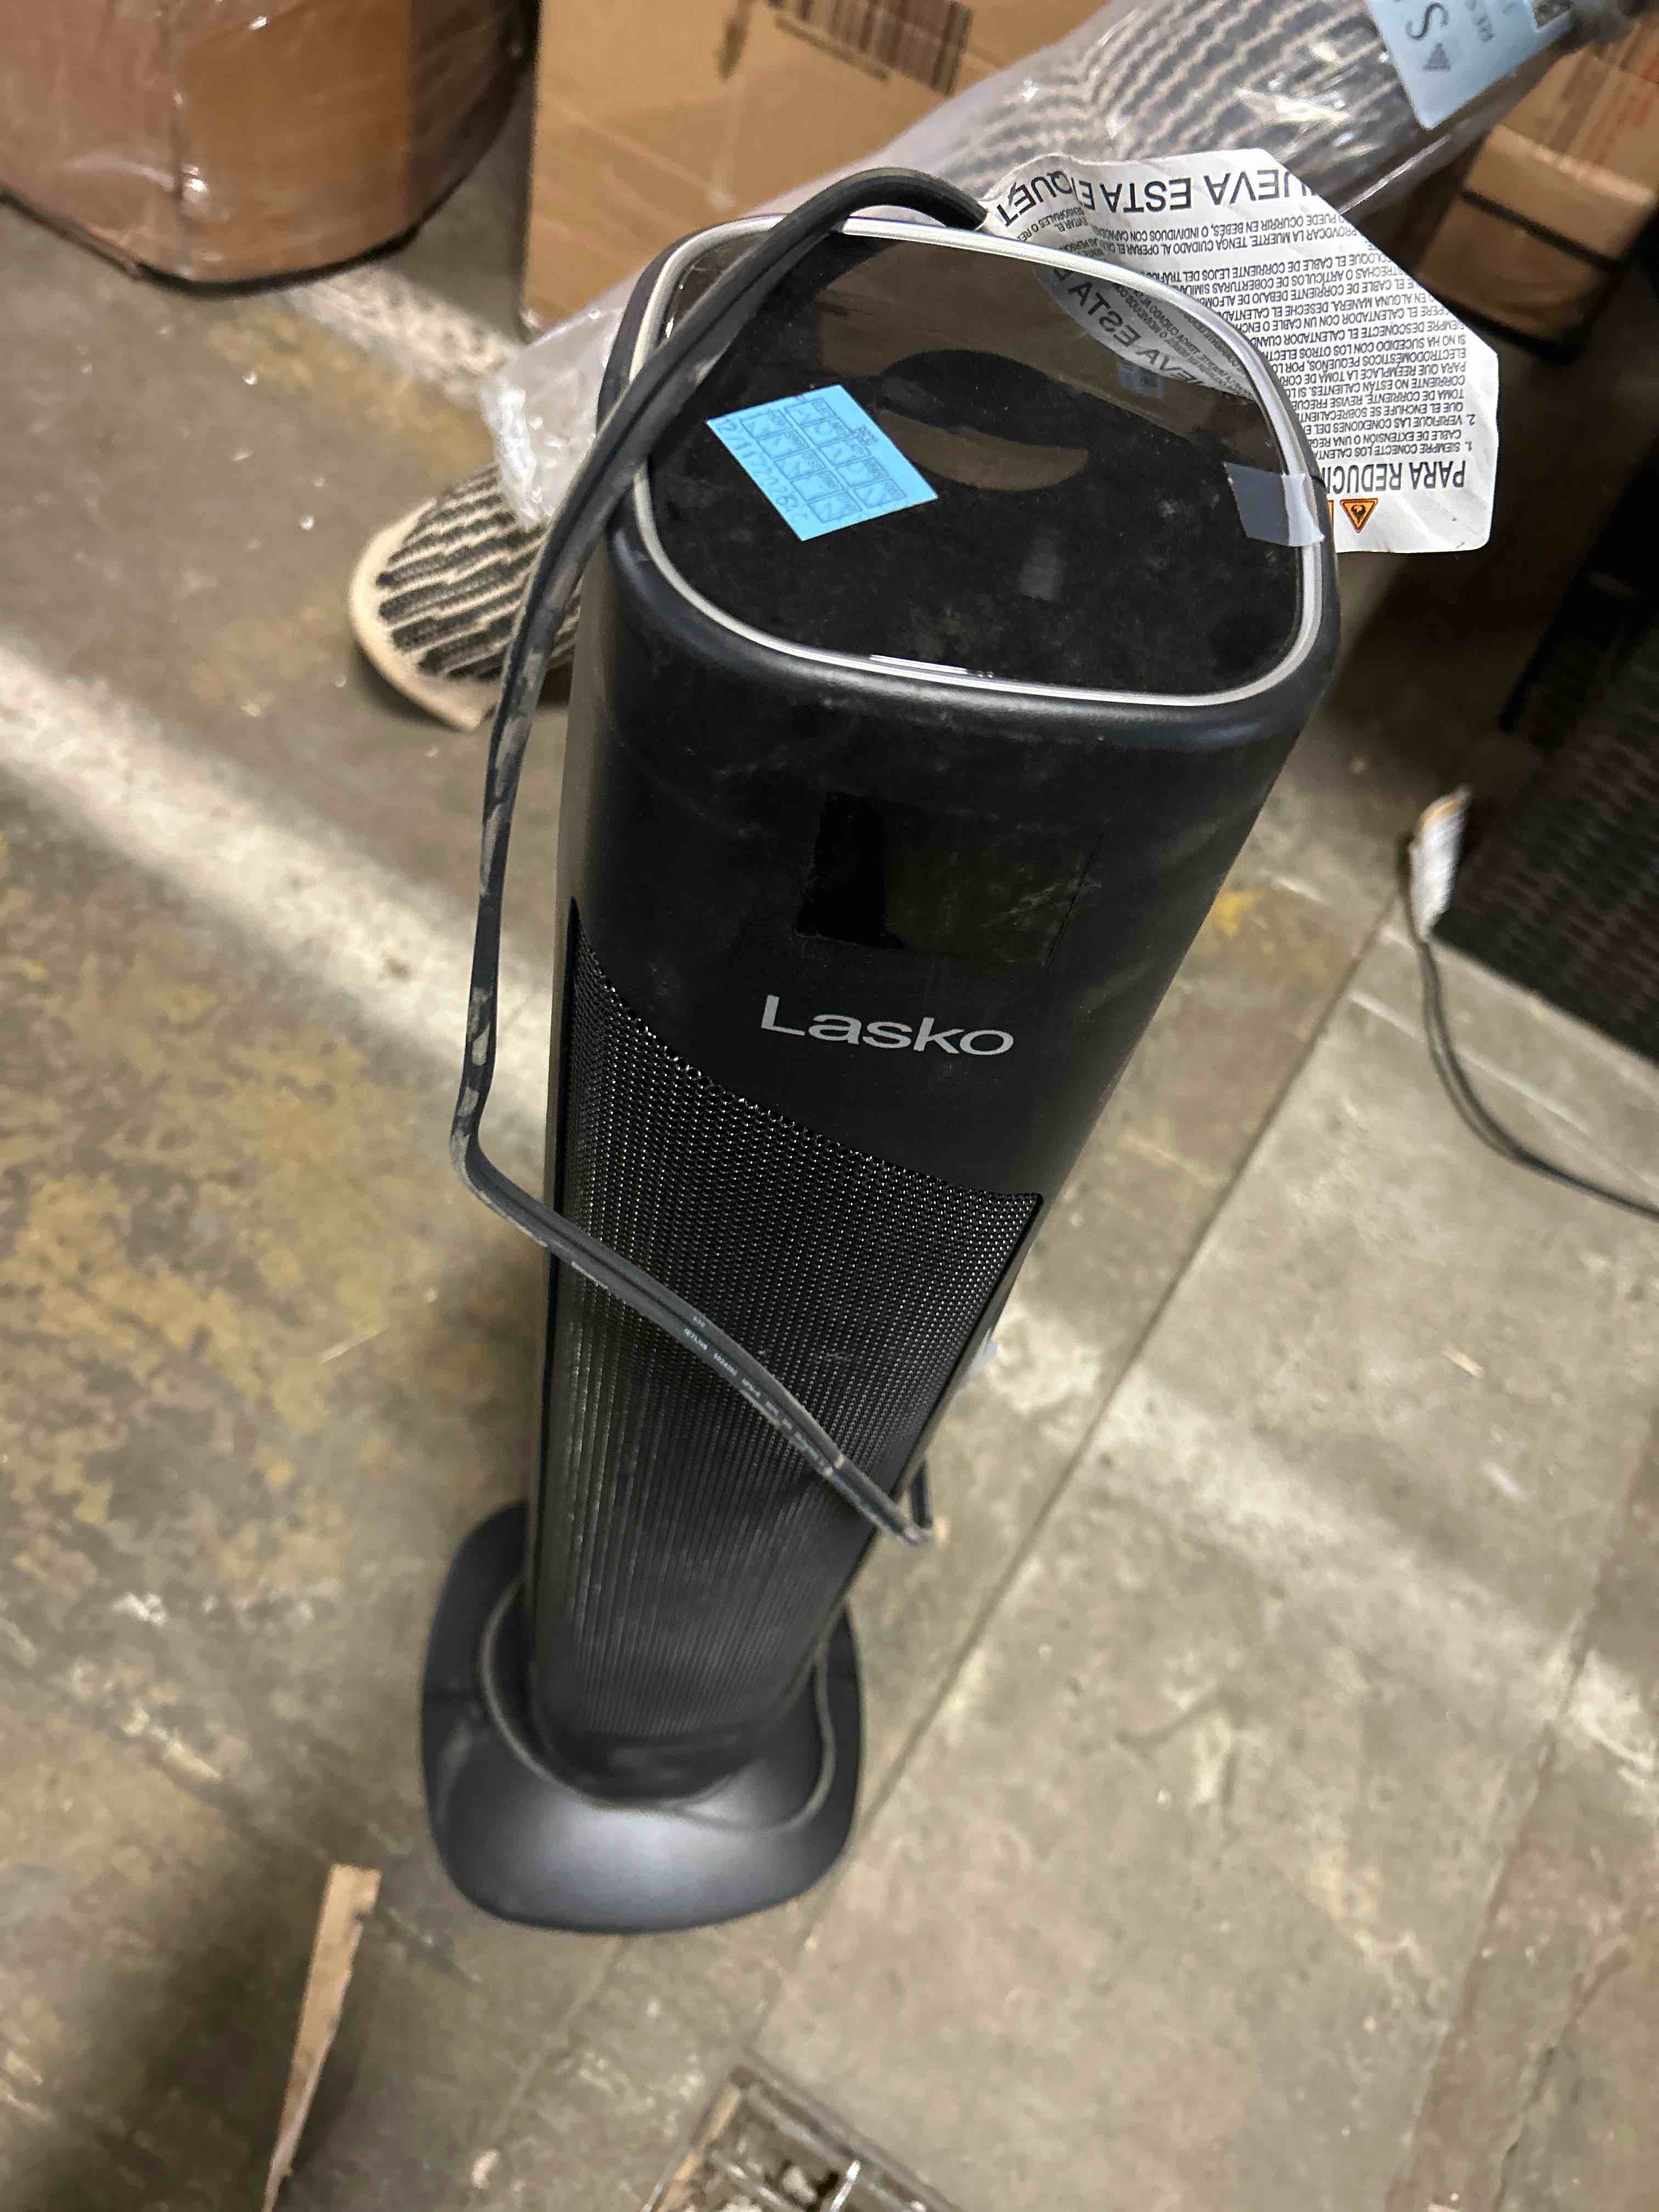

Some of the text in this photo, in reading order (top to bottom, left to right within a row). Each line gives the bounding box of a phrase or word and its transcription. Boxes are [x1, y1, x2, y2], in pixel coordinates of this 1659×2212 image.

[1099, 178, 1190, 213] ESTA
[1261, 216, 1303, 230] OCURRIR
[1306, 213, 1336, 226] PUEDE
[1031, 224, 1038, 232] O
[1201, 226, 1208, 237] O
[1211, 223, 1243, 237] BEBÉS,
[1246, 221, 1258, 233] EN
[1130, 230, 1147, 241] CON
[1149, 227, 1198, 241] INDIVIDUOS
[1293, 230, 1304, 242] LA
[1216, 237, 1247, 250] TENGA
[1250, 233, 1290, 247] MUERTE.
[1117, 244, 1125, 253] EL
[1126, 245, 1159, 255] OPERAR
[1161, 244, 1170, 255] AL
[1173, 240, 1213, 254] CUIDADO
[1288, 261, 1300, 272] DE
[1303, 257, 1332, 271] CABLE
[1335, 256, 1346, 267] EL
[1202, 268, 1229, 280] LEJOS
[1232, 262, 1285, 278] CORRIENTE
[1346, 269, 1352, 280] O
[1183, 271, 1199, 282] DEL
[1276, 276, 1288, 287] DE
[1291, 270, 1343, 287] ARTÍCULOS
[1212, 278, 1273, 293] COBERTURAS
[1346, 283, 1359, 294] DE
[1362, 280, 1391, 292] CABLE
[1395, 279, 1404, 289] EL
[1252, 290, 1288, 303] DEBAJO
[1290, 284, 1344, 300] CORRIENTE
[1238, 294, 1250, 305] DE
[1375, 294, 1412, 307] ALGUNA
[1415, 293, 1425, 303] EN
[1285, 302, 1328, 316] DESECHE
[1331, 297, 1372, 311] MANERA.
[1272, 306, 1282, 317] EL
[1342, 308, 1403, 324] CALENTADOR
[1407, 307, 1417, 317] EL
[1273, 318, 1301, 330] CABLE
[1304, 317, 1317, 328] UN
[1319, 314, 1339, 326] CON
[1263, 321, 1269, 331] O
[1361, 321, 1424, 338] DESCONECTE
[1284, 330, 1345, 345] CALENTADOR
[1347, 328, 1358, 338] EL
[1376, 338, 1424, 352] SUCEDIDO
[1427, 336, 1440, 347] HA
[1442, 335, 1455, 346] NO
[1458, 335, 1465, 345] SI
[1300, 347, 1330, 358] OTROS
[1333, 345, 1351, 356] LOS
[1354, 342, 1374, 353] CON
[1363, 348, 1465, 366] ELECTRODOMÉSTICOS
[1285, 362, 1305, 373] POR
[1307, 357, 1359, 373] PEQUEÑOS,
[1419, 364, 1438, 375] QUE
[1441, 362, 1465, 374] PARA
[1319, 372, 1344, 383] TOMA
[1347, 370, 1358, 381] LA
[1361, 365, 1415, 380] REEMPLACE
[1305, 374, 1316, 384] DE
[1395, 379, 1408, 389] NO
[1411, 375, 1465, 388] CORRIENTE
[1298, 387, 1306, 397] SI
[1309, 383, 1360, 396] CALIENTES.
[1363, 380, 1392, 394] ESTÁN
[1423, 391, 1435, 400] DE
[1437, 389, 1464, 399] TOMA
[1330, 395, 1362, 408] REVISE
[1297, 402, 1463, 423] QUE EL ENCHUFE SE SOBRECALIENT
[1395, 417, 1410, 428] LAS
[1413, 415, 1462, 427] VERIFIQUE
[1466, 414, 1475, 425] 2.
[1314, 424, 1330, 434] DEL
[1333, 418, 1391, 433] CONEXIONES
[1354, 435, 1361, 444] O
[1363, 431, 1414, 448] EXTENSIÓN
[1417, 431, 1429, 441] DE
[1432, 430, 1461, 440] CABLE
[1333, 436, 1351, 446] UNA
[1465, 441, 1472, 450] 1.
[1355, 445, 1372, 456] LOS
[1375, 443, 1418, 455] CONECTE
[1420, 442, 1460, 453] SIEMPRE
[1321, 461, 1465, 497] PARA REDUCI
[761, 995, 1014, 1056] Lasko
